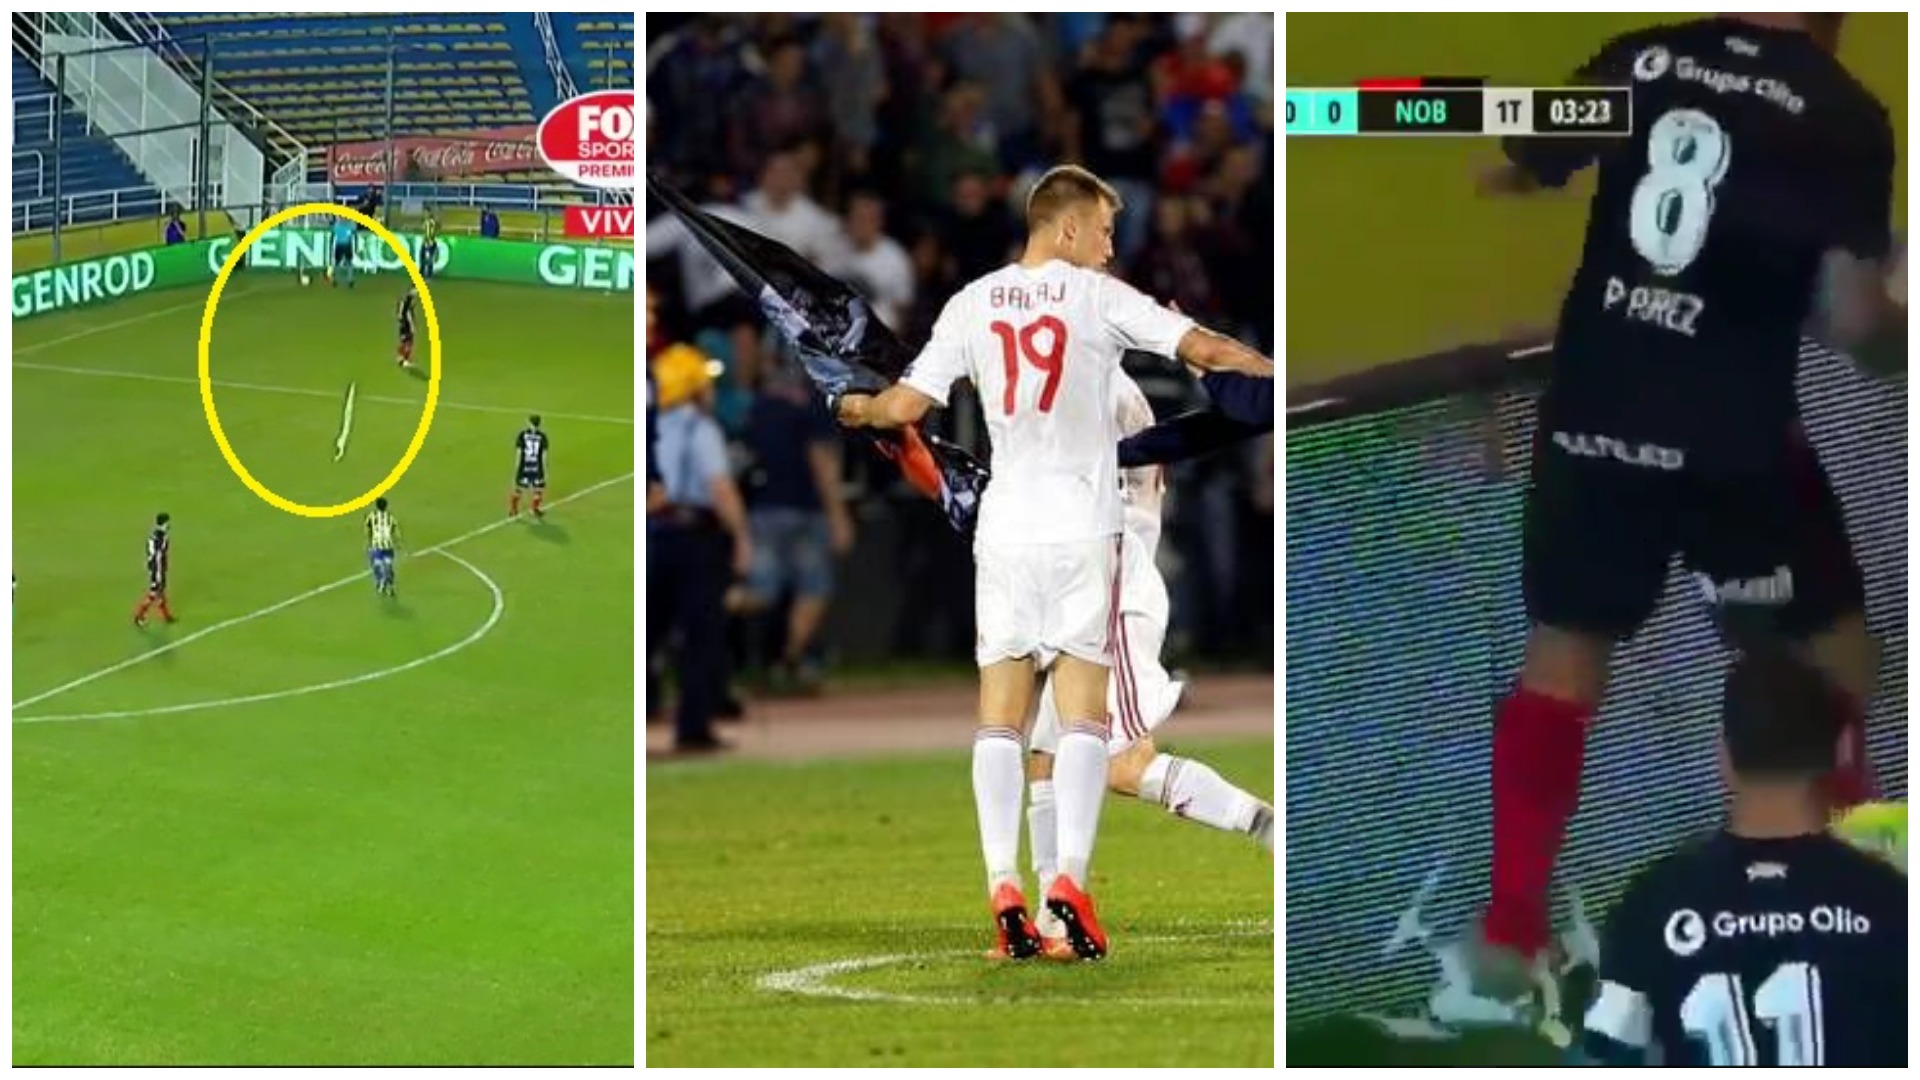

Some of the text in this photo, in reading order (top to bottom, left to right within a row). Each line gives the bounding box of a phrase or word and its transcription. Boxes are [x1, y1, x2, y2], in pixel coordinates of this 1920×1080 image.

[1630, 108, 1731, 275] 8
[12, 251, 155, 317] GENROD
[208, 230, 449, 274] GENOD
[990, 281, 1067, 311] BALAJ
[990, 315, 1067, 416] 19
[1712, 905, 1870, 936] Grupo Olio
[1679, 961, 1826, 1066] 11
